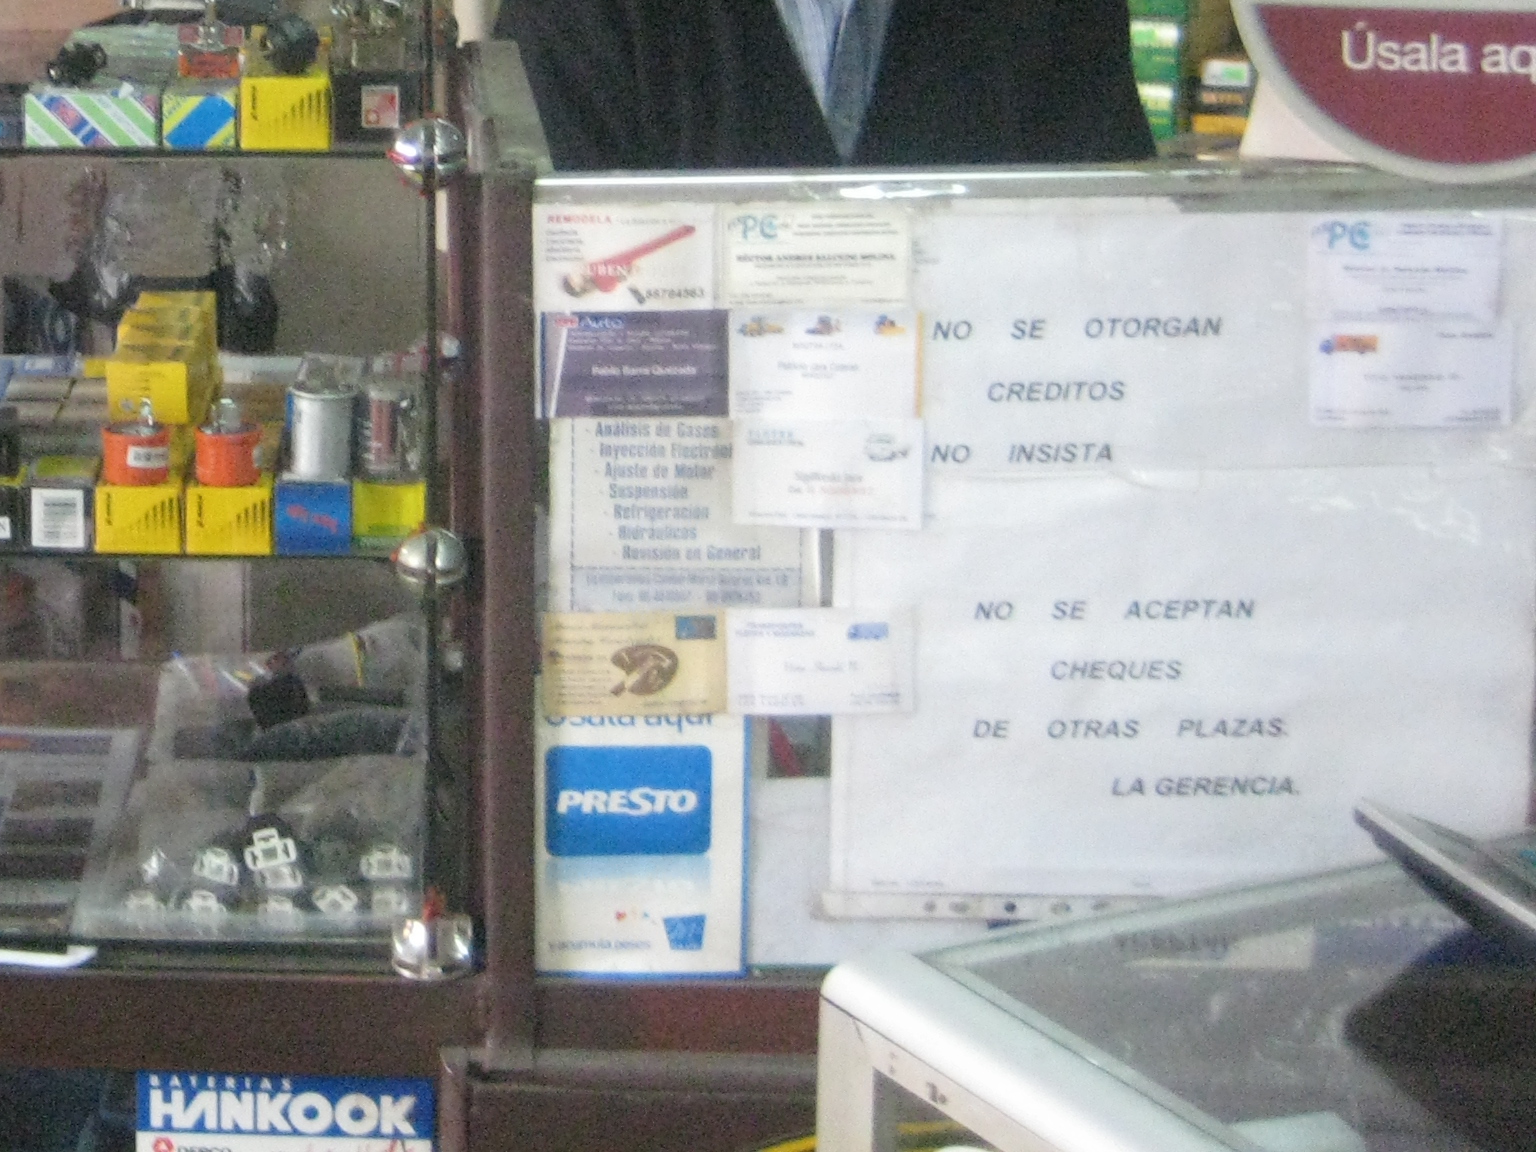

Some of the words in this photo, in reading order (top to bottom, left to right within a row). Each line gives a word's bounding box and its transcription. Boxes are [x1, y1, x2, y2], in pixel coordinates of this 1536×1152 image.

[1340, 20, 1471, 74] Úsala
[546, 213, 613, 226] REMODELA
[932, 320, 972, 340] NO
[1011, 320, 1047, 340] SE
[1084, 316, 1223, 340] OTORGAN
[987, 381, 1125, 403] CREDITOS
[655, 423, 672, 437] de
[930, 444, 971, 464] NO
[1008, 443, 1114, 464] INSISTA
[604, 462, 649, 481] Ajuste
[653, 464, 670, 479] de
[974, 600, 1015, 622] NO
[1051, 600, 1088, 621] SE
[1124, 598, 1257, 621] ACEPTAN
[1050, 659, 1182, 681] CHEQUES
[973, 718, 1009, 739] DE
[1047, 717, 1140, 739] OTRAS
[1177, 717, 1290, 739] PLAZAS.
[1111, 776, 1146, 797] LA
[1153, 776, 1300, 797] GERENCIA.
[556, 786, 698, 817] PRESTO
[149, 1074, 293, 1091] BATERIAS
[149, 1088, 417, 1137] HANKOOK
